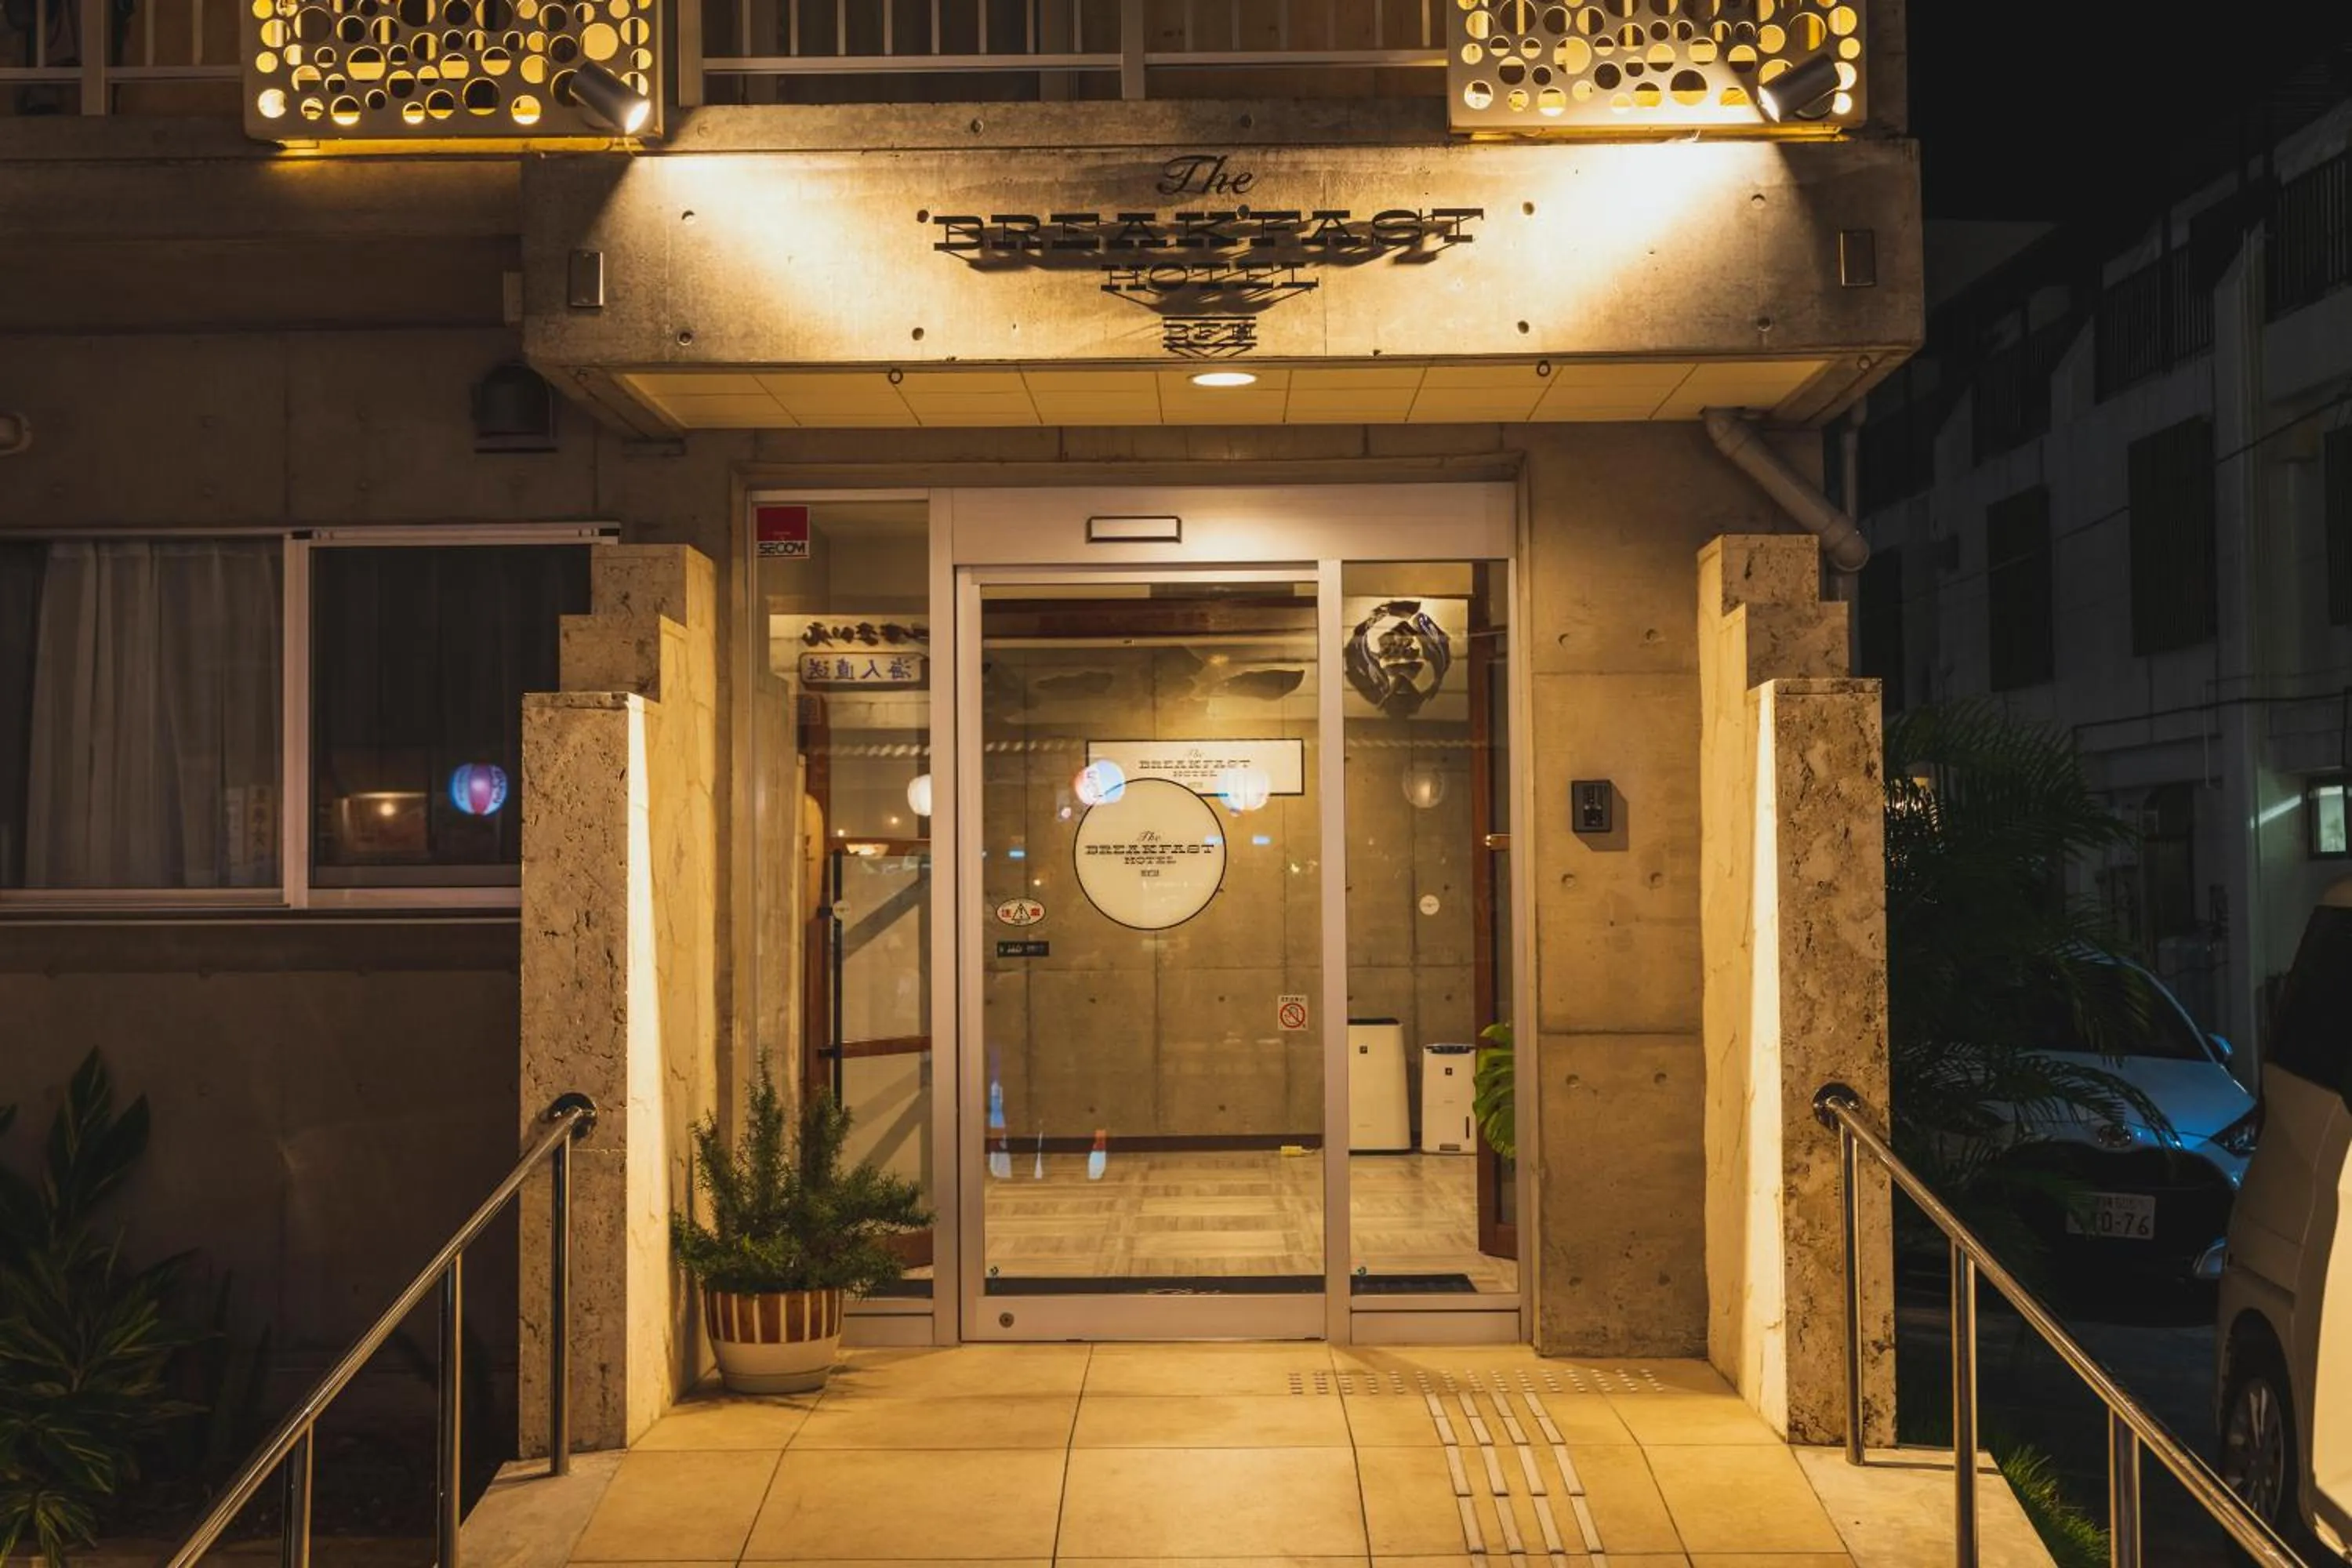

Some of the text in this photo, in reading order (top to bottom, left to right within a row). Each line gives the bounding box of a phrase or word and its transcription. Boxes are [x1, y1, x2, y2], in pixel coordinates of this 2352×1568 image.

[1156, 155, 1254, 195] The
[934, 208, 1484, 252] BREAKFAST
[1100, 263, 1319, 292] HOTEL
[758, 542, 805, 555] SECOM
[1085, 844, 1214, 855] BREAKFAST
[1124, 856, 1177, 865] HOTEL
